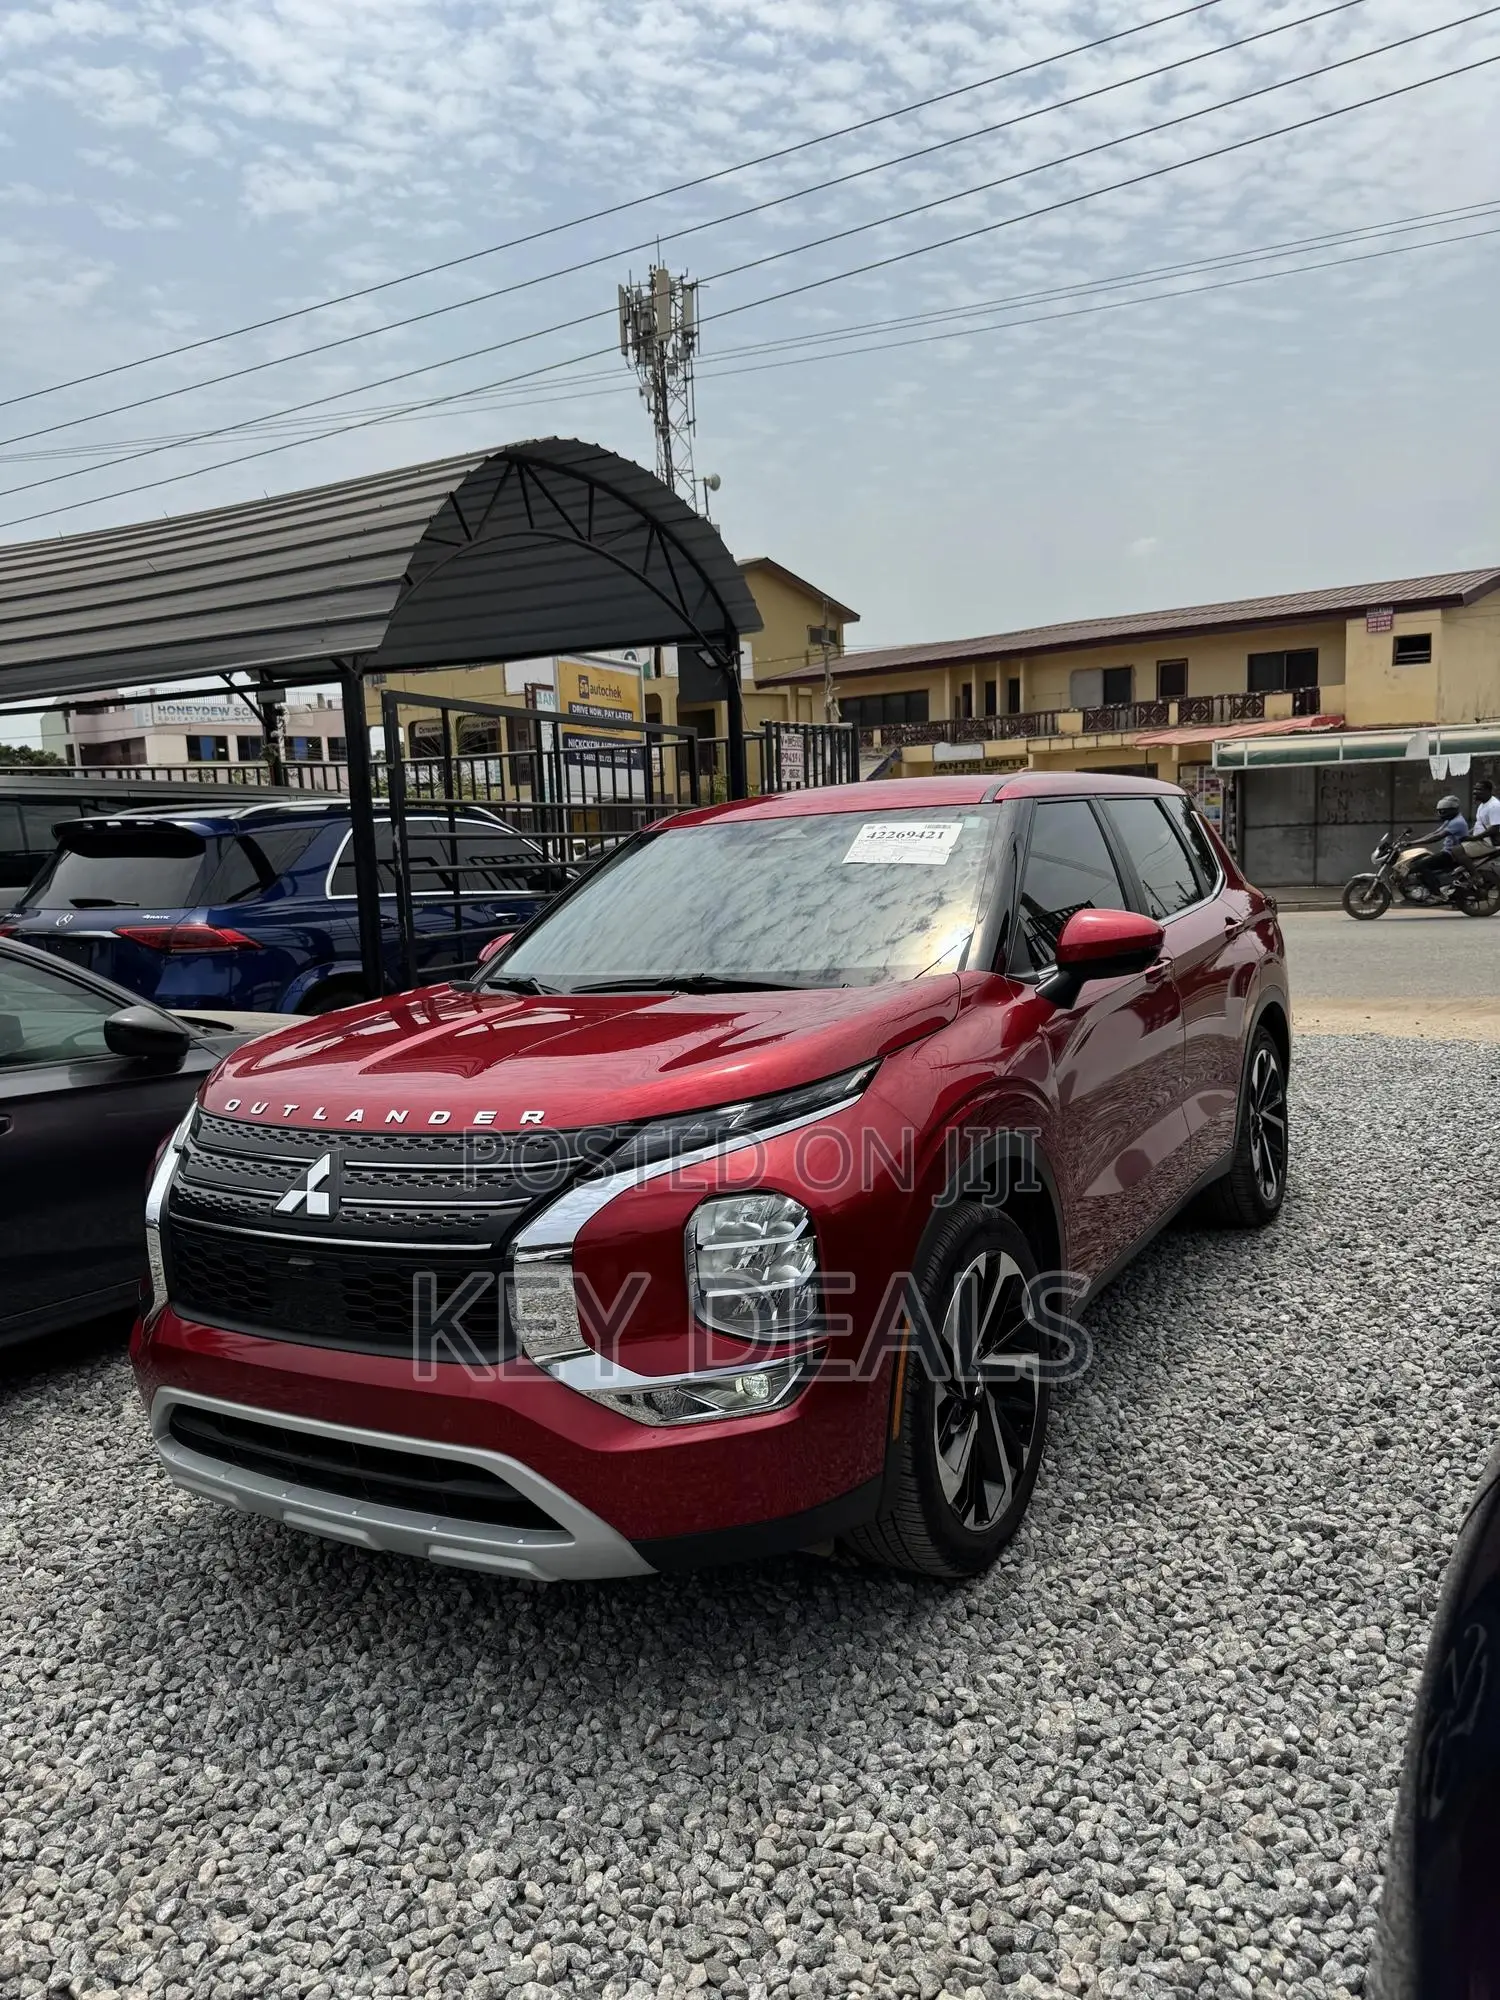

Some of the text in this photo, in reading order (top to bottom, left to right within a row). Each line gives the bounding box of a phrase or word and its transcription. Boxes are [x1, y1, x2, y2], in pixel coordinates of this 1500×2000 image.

[590, 684, 622, 699] autochek
[157, 705, 230, 716] HONEYDEW
[572, 704, 588, 715] DRIVE
[604, 709, 615, 719] PAY
[985, 758, 1029, 767] LIMITE
[866, 830, 945, 840] 42269421
[224, 1098, 545, 1126] OUTLANDER
